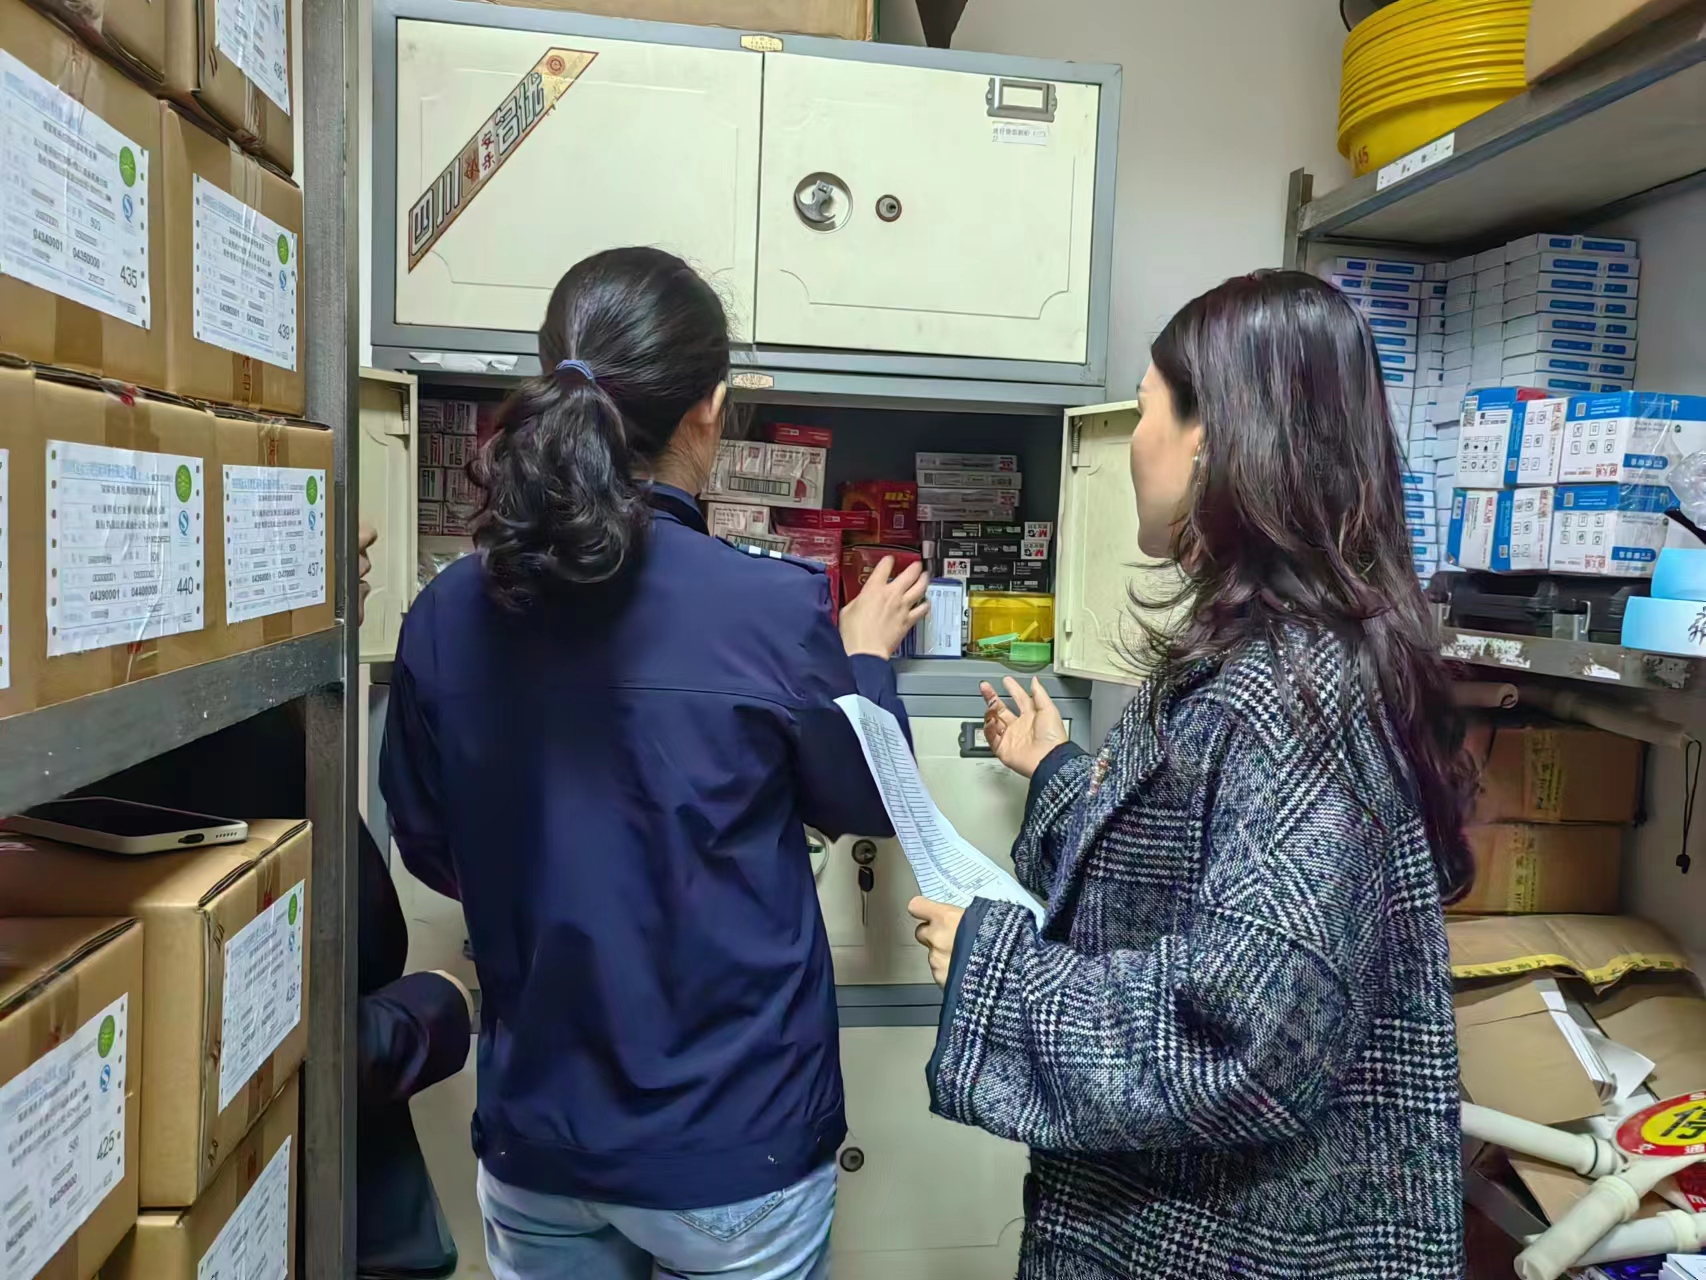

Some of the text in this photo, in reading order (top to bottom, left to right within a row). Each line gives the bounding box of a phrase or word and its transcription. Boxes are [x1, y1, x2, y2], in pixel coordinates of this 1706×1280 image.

[411, 157, 461, 257] 四川
[120, 265, 138, 288] 435
[278, 323, 290, 340] 439
[307, 561, 319, 577] 437
[176, 576, 194, 596] 440
[96, 1129, 115, 1161] 425
